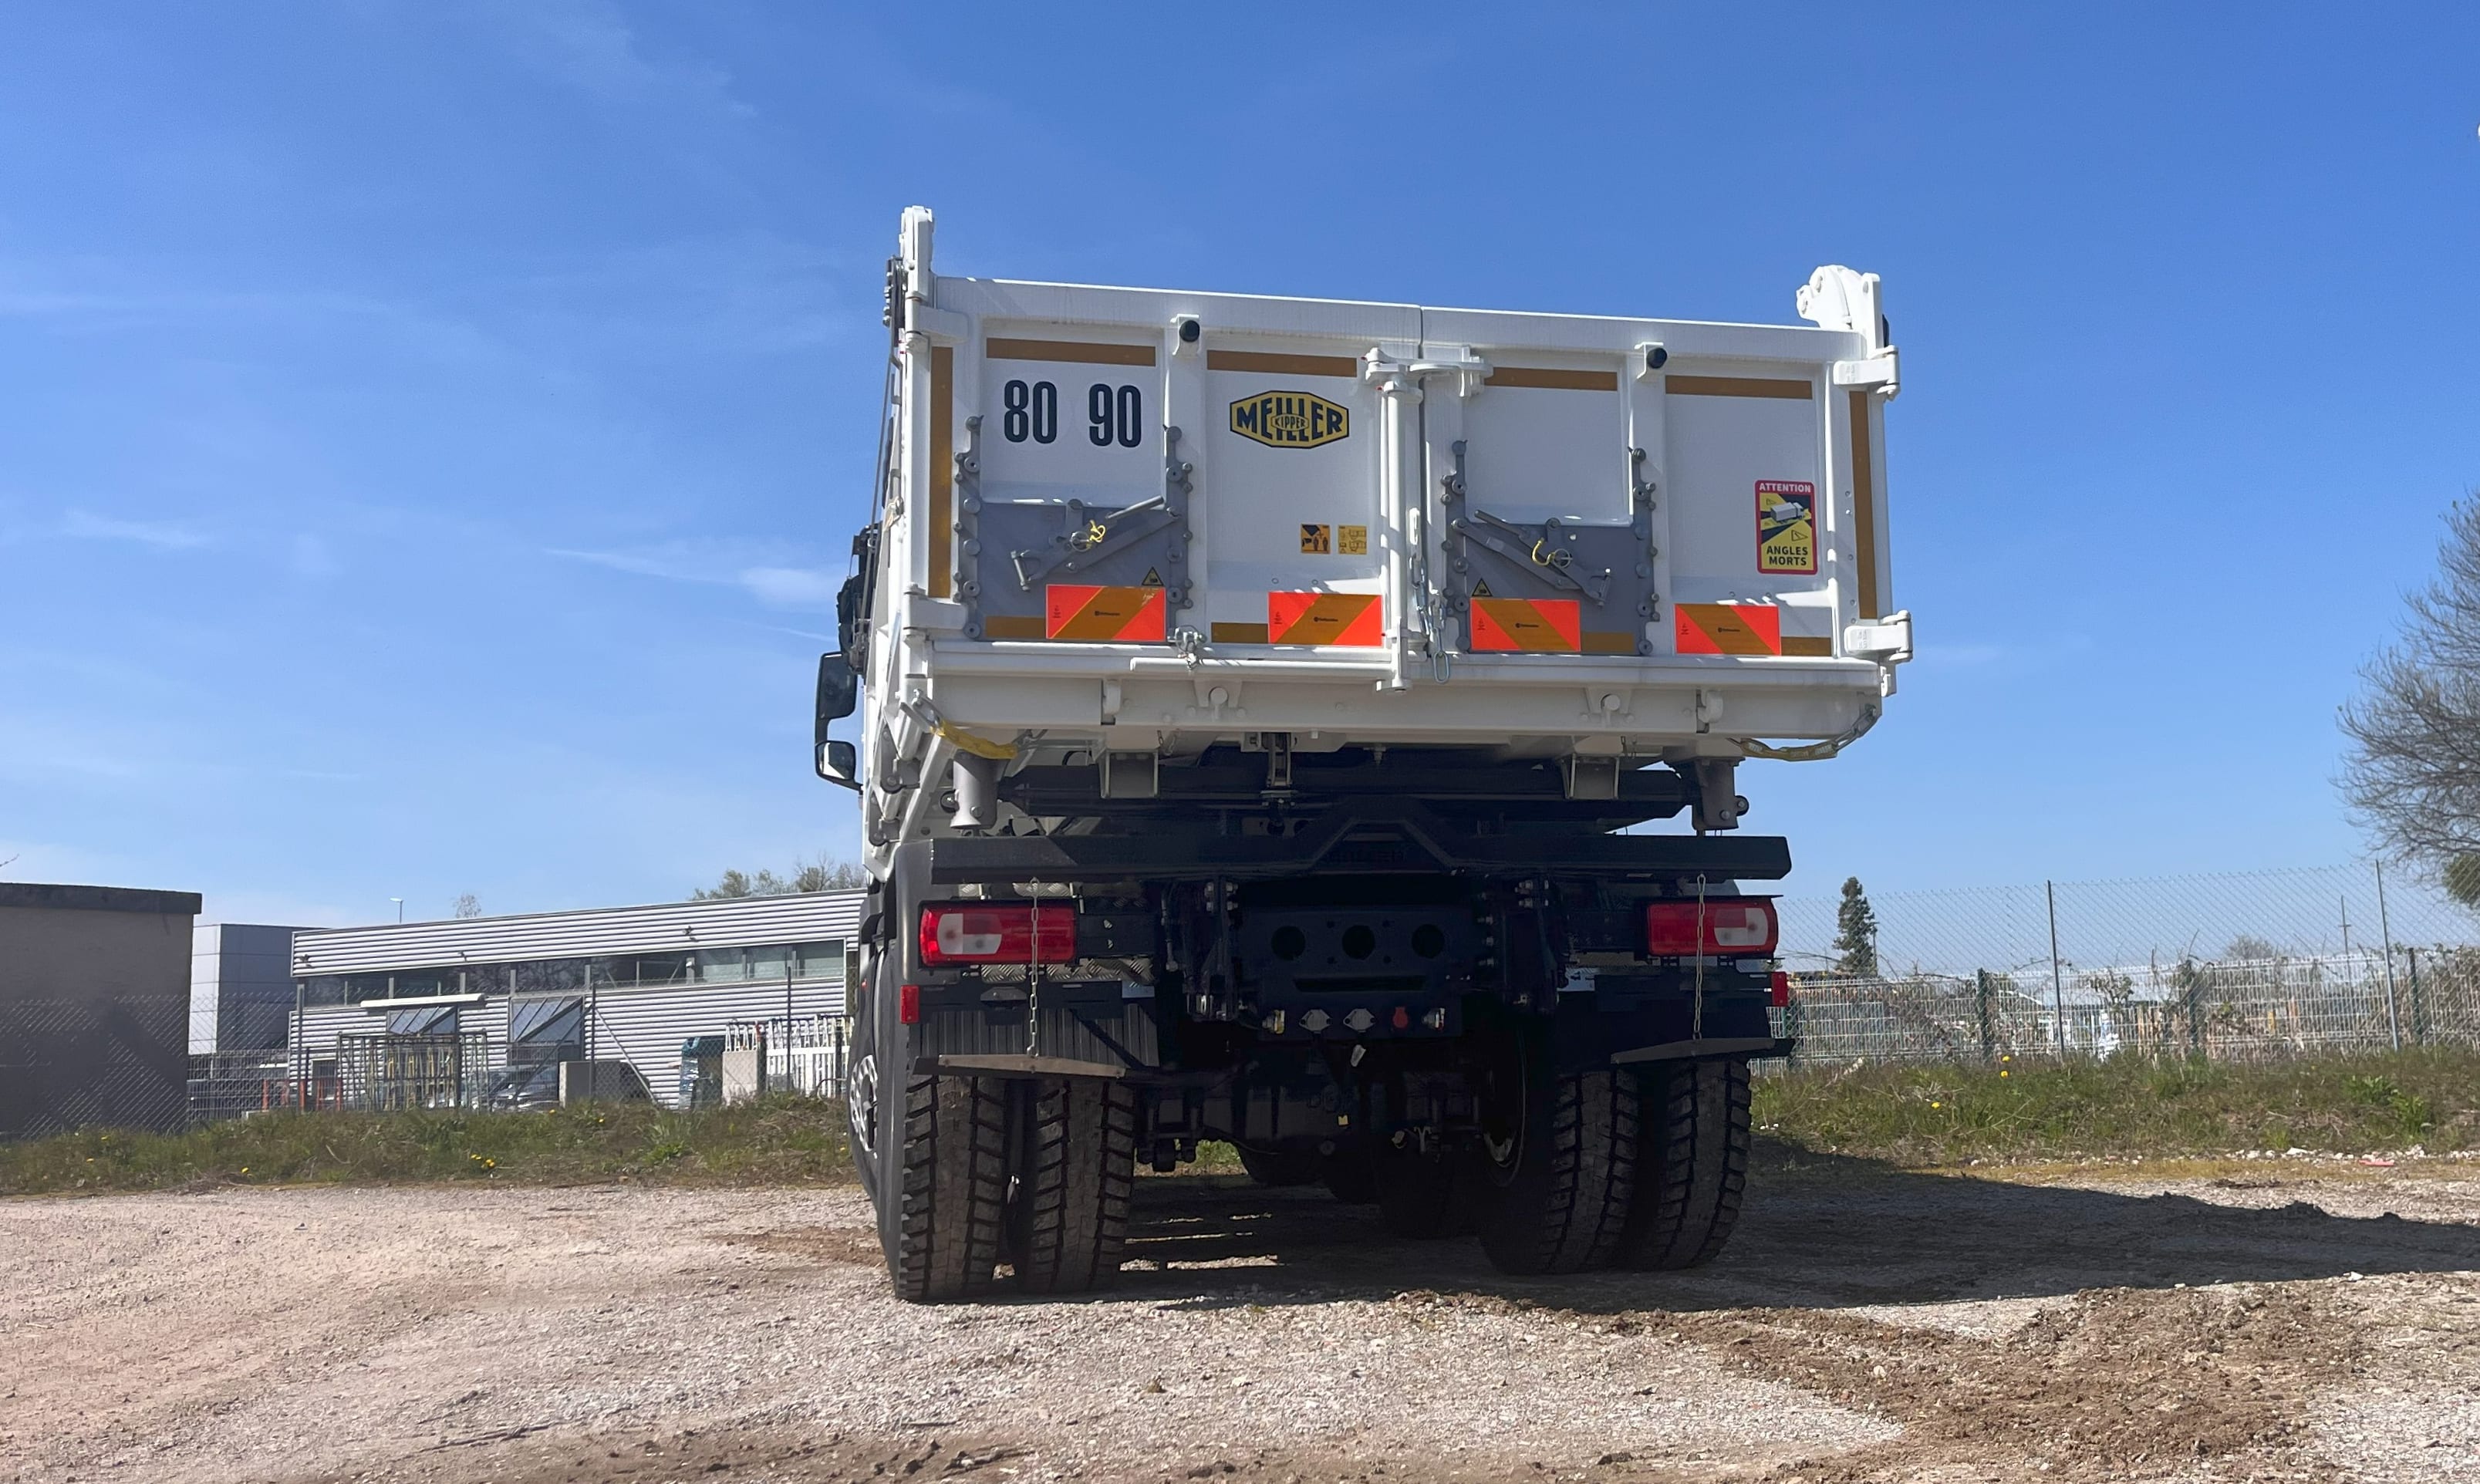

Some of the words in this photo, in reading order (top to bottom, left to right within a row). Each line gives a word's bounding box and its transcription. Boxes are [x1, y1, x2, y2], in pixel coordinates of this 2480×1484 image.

[1004, 379, 1058, 444] 80
[1088, 383, 1142, 448] 90
[1237, 396, 1343, 442] MEILLER
[1274, 417, 1306, 429] KIPPER
[1759, 482, 1811, 493] ATTENTION
[1766, 545, 1808, 556] ANGLES
[1769, 556, 1807, 566] MORTS
